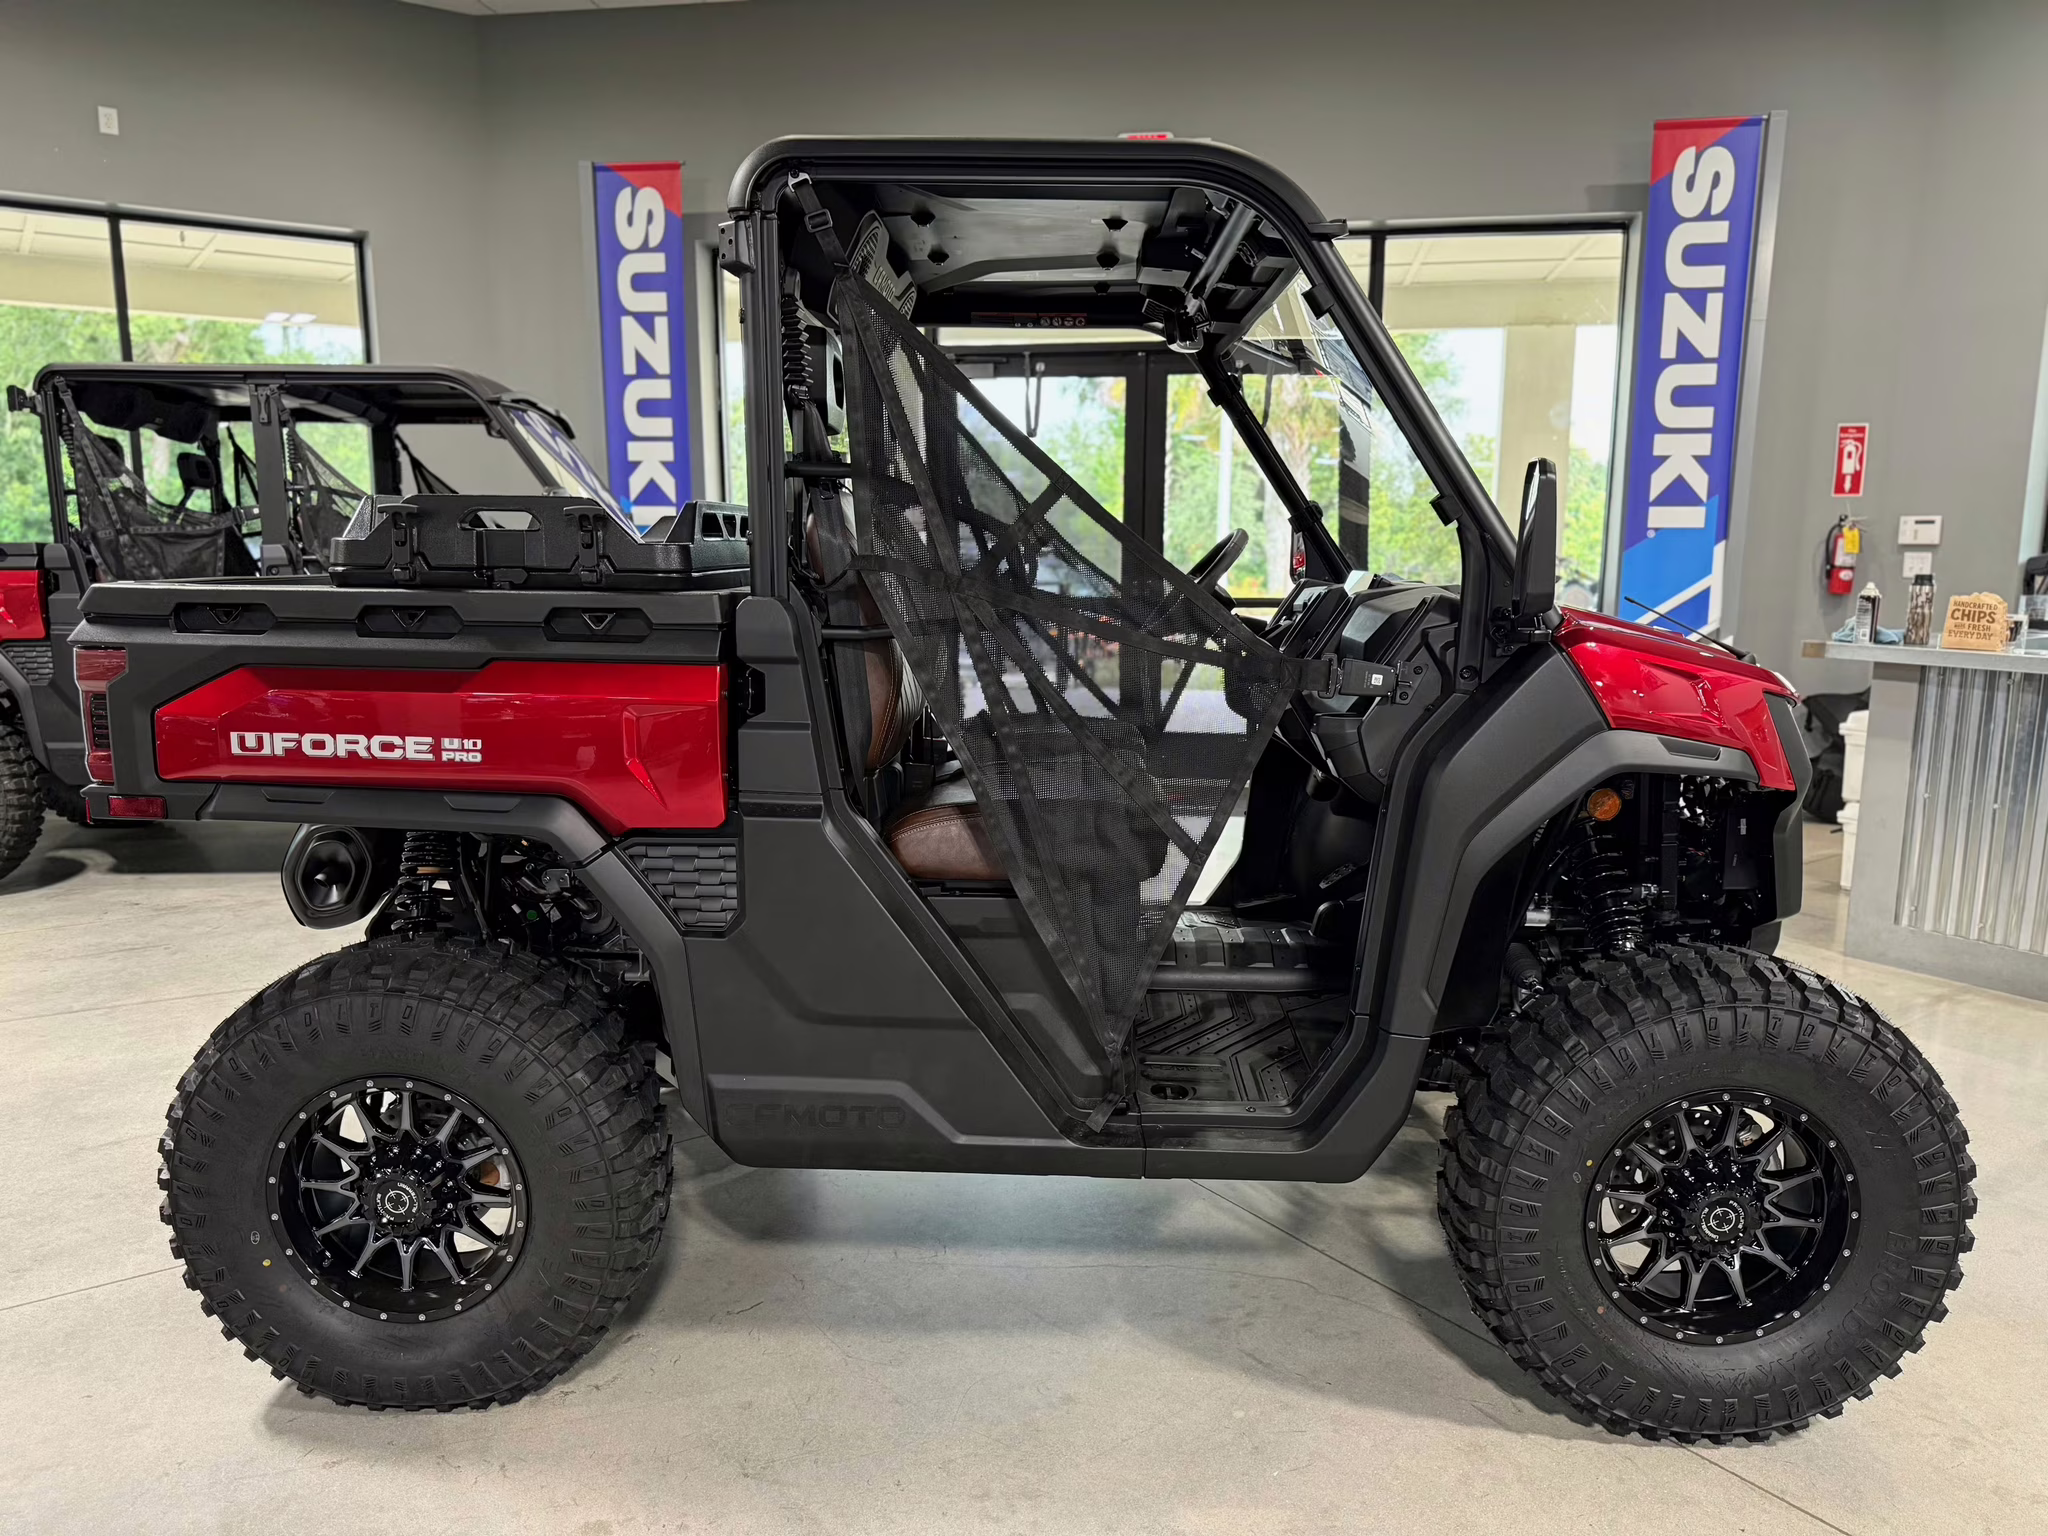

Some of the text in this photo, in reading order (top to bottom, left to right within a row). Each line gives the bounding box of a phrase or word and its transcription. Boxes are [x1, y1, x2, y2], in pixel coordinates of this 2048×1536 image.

[1647, 146, 1736, 529] SUZUKI
[614, 186, 678, 527] SUZUKI
[1953, 600, 1998, 610] HANDCRAFTED
[1950, 608, 1997, 624] CHIPS
[1967, 623, 1991, 632] FRESH
[230, 731, 435, 761] UFORCE
[441, 751, 482, 763] PRO
